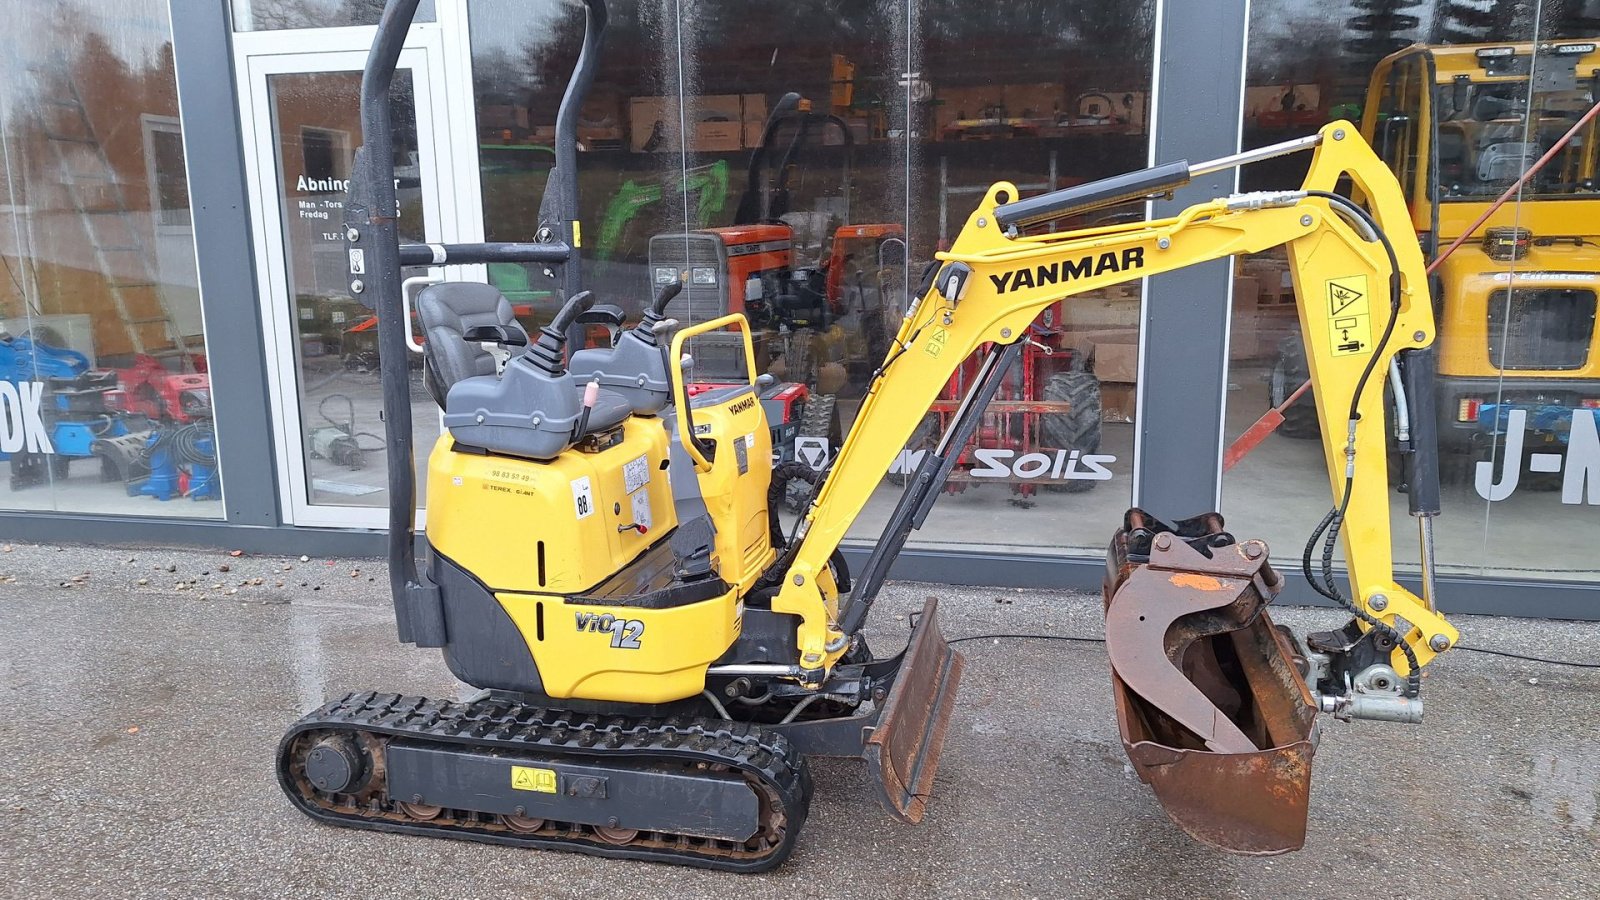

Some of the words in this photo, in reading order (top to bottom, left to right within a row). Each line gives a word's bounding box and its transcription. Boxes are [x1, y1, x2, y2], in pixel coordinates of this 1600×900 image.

[299, 211, 328, 219] Fredag
[989, 246, 1145, 294] YANMAR
[0, 380, 55, 453] DK
[728, 396, 756, 416] YANMAR
[969, 448, 1117, 480] Solis
[577, 495, 588, 515] 88
